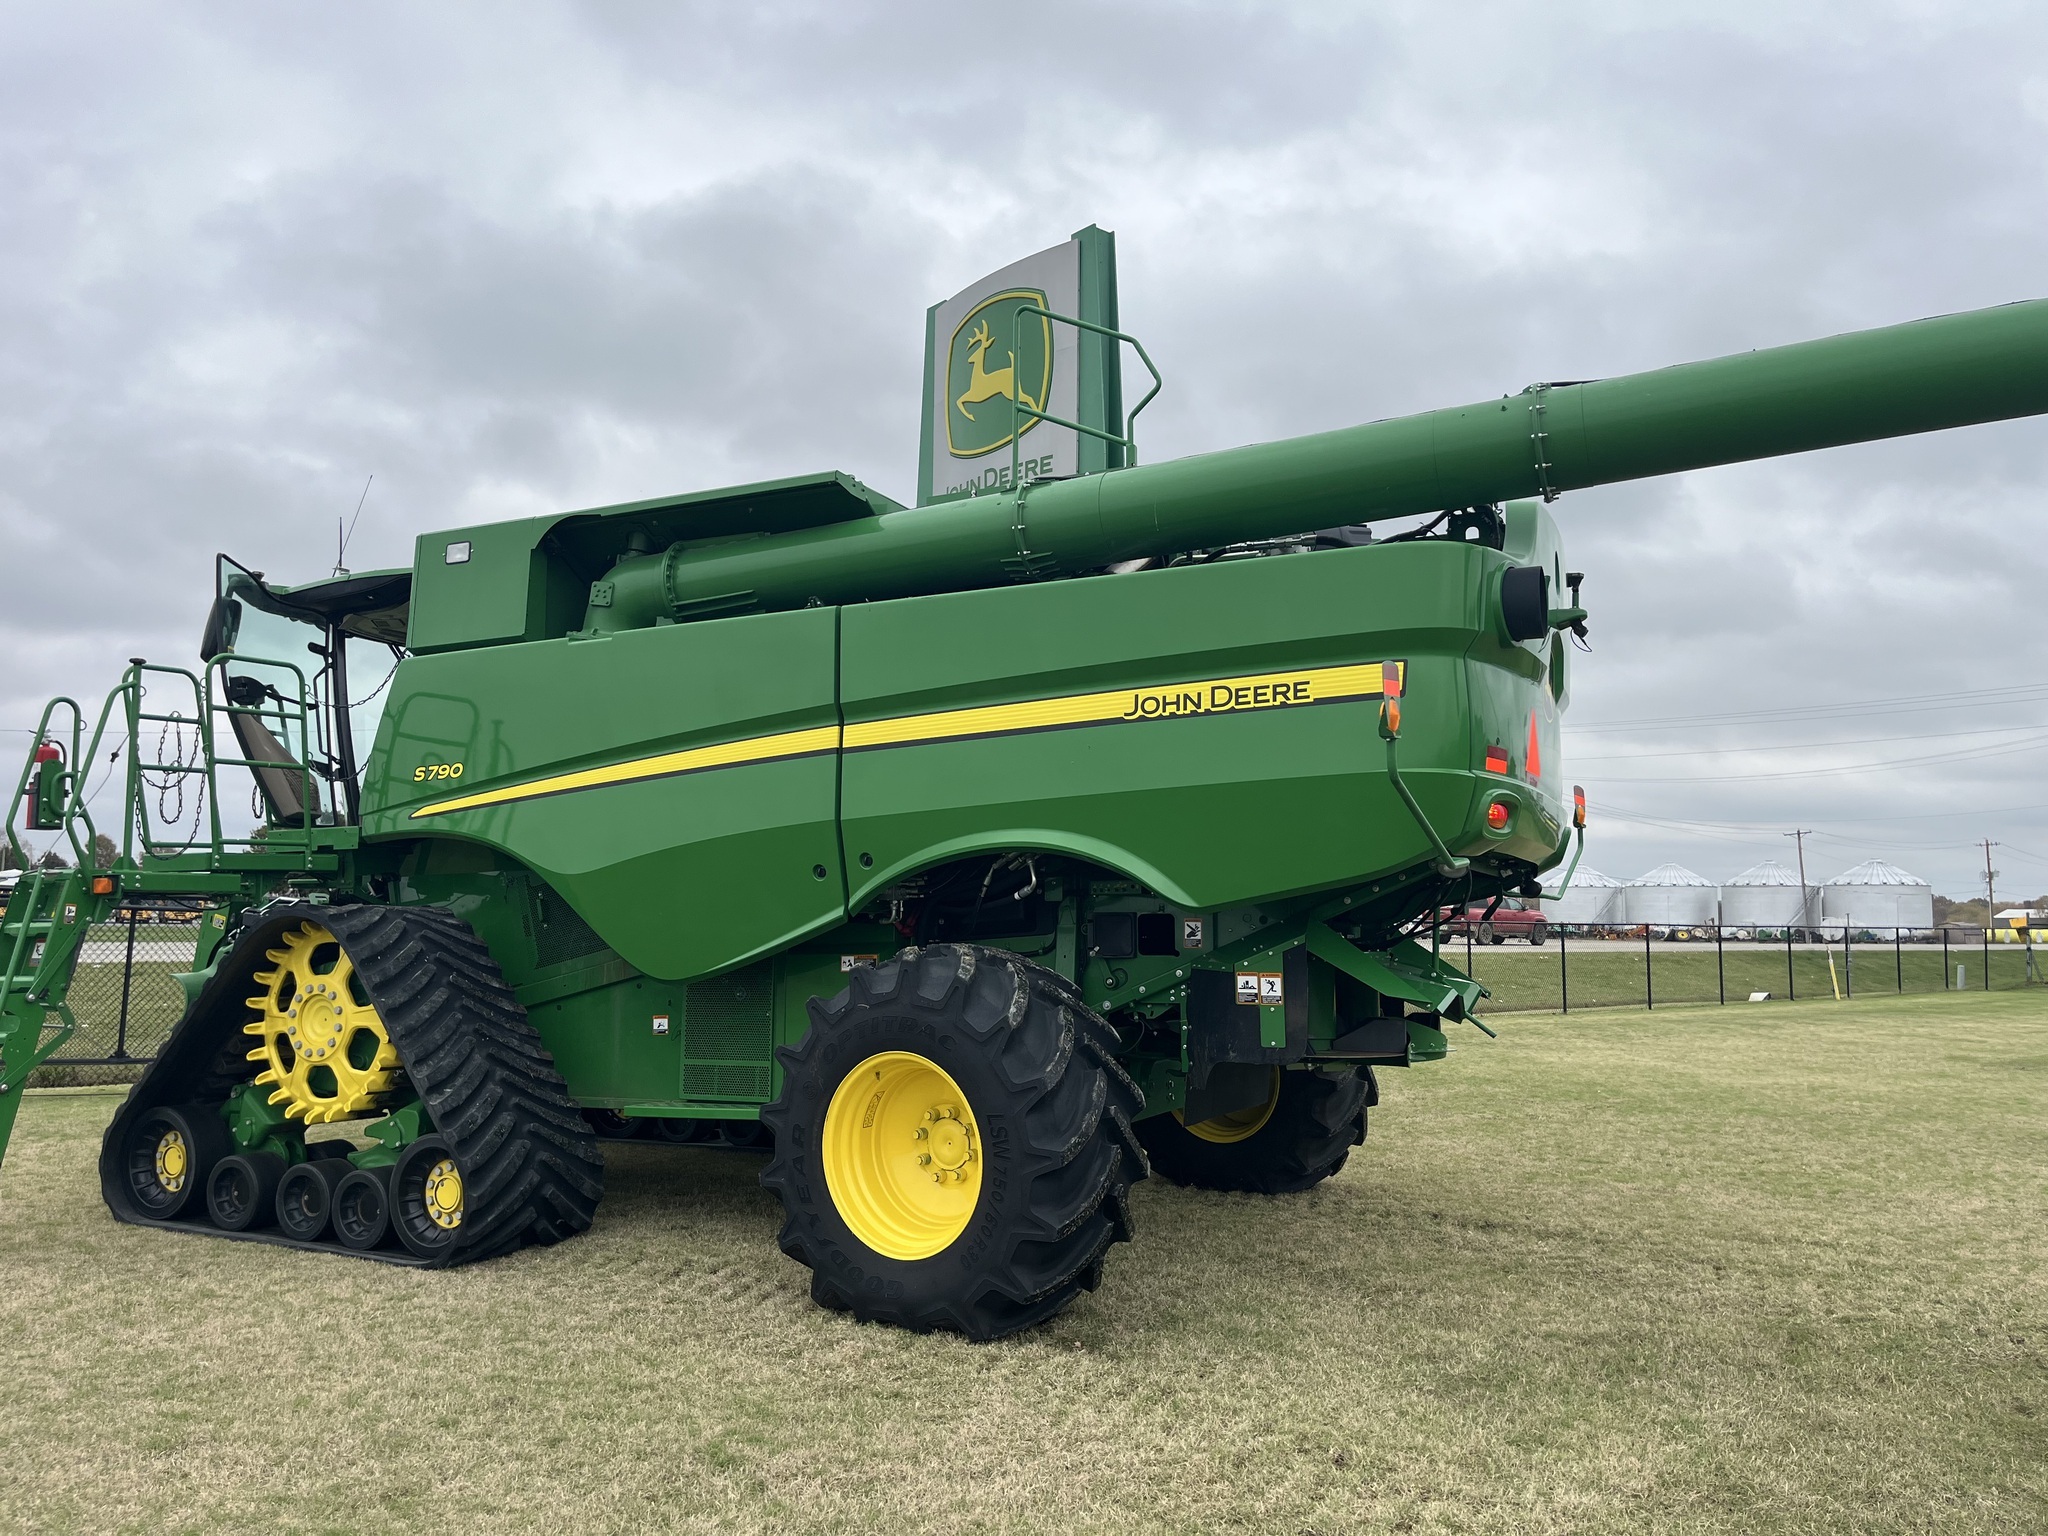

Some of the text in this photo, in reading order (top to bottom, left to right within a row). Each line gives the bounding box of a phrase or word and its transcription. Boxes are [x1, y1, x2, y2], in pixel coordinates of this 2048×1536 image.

[1124, 680, 1311, 717] JOHN DEERE
[413, 762, 464, 782] S790
[823, 1015, 957, 1064] OPTITRAC
[986, 1112, 1011, 1161] LSW
